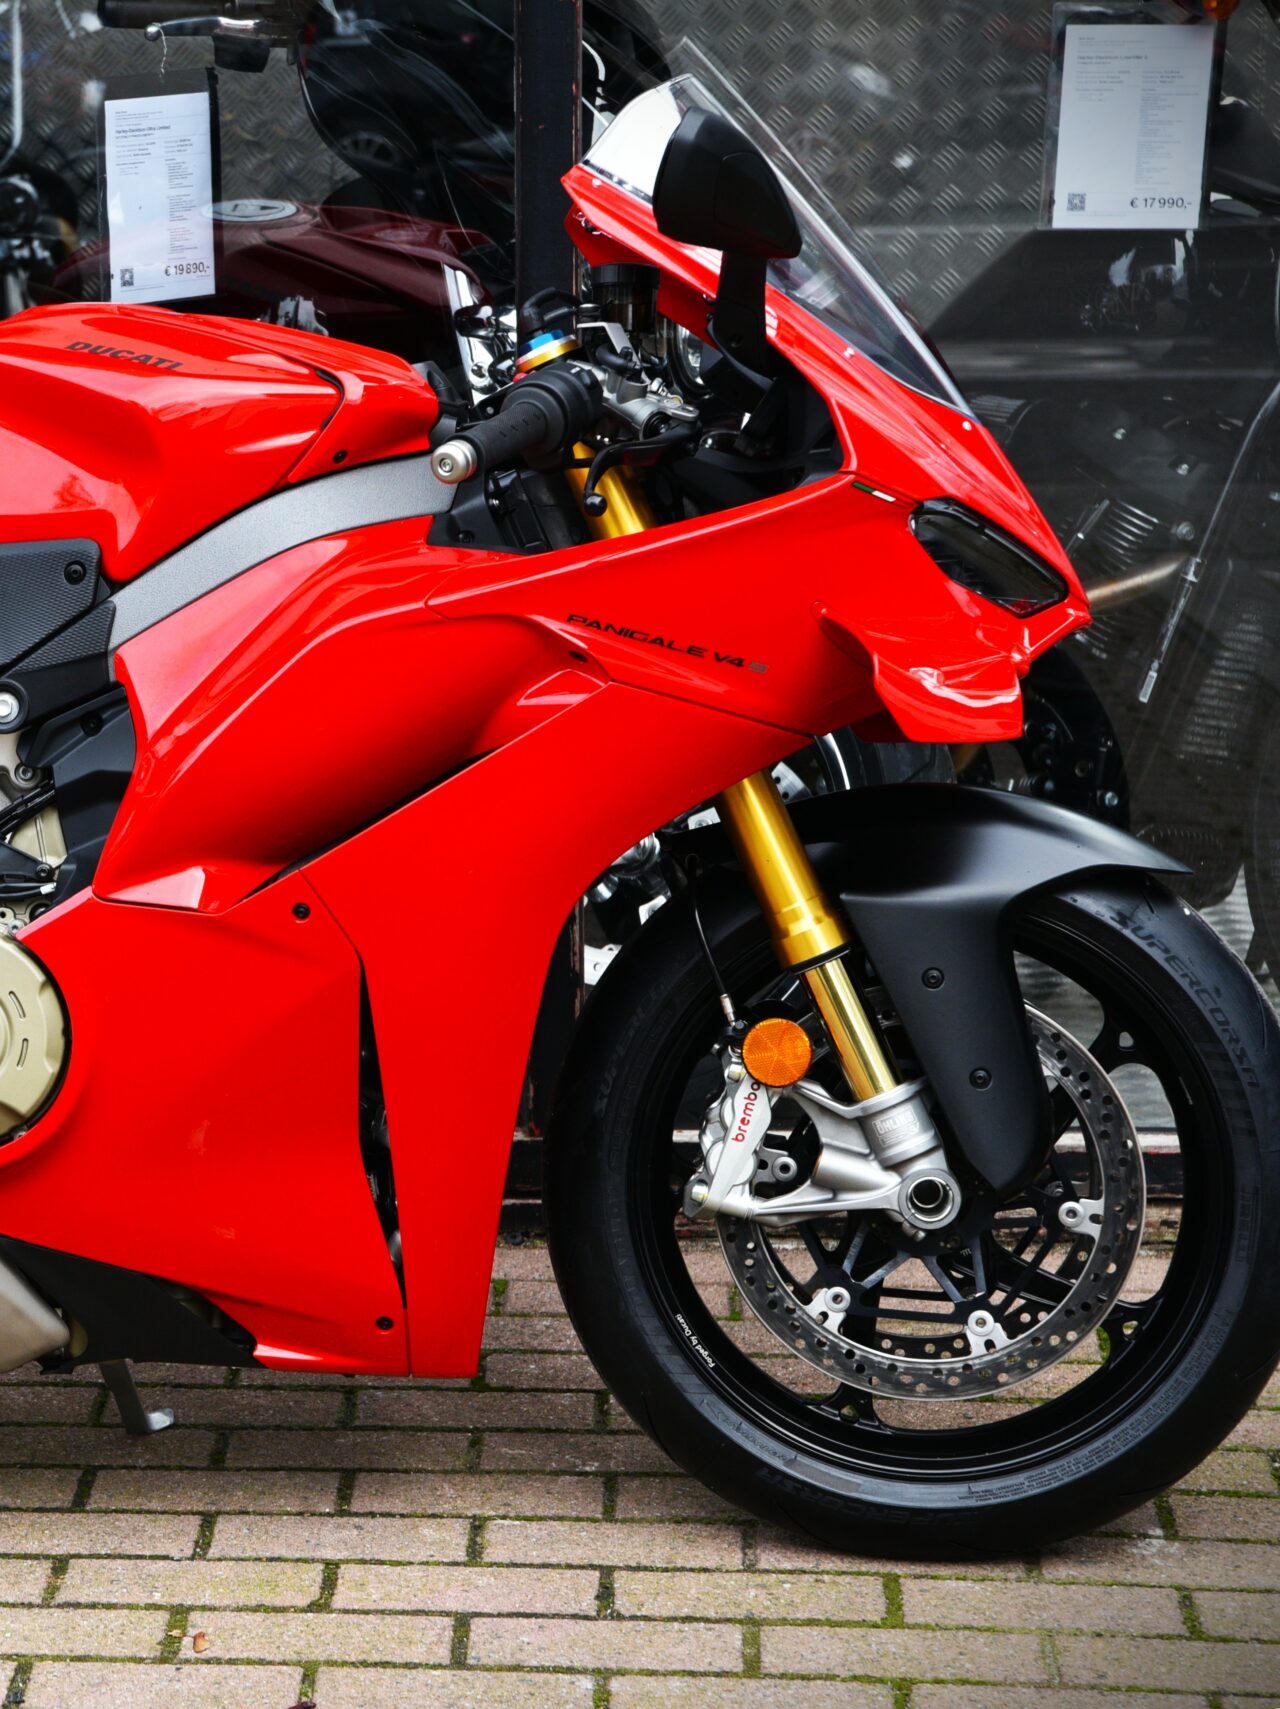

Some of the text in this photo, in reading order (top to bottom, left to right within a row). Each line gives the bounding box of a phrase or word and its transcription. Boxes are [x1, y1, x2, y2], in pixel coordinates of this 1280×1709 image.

[64, 341, 183, 370] DUCATI
[566, 613, 709, 659] PANIGALE
[1109, 911, 1260, 1089] SUPERCORSA
[731, 1081, 761, 1143] brembo
[674, 1313, 716, 1368] Forged by Ducati
